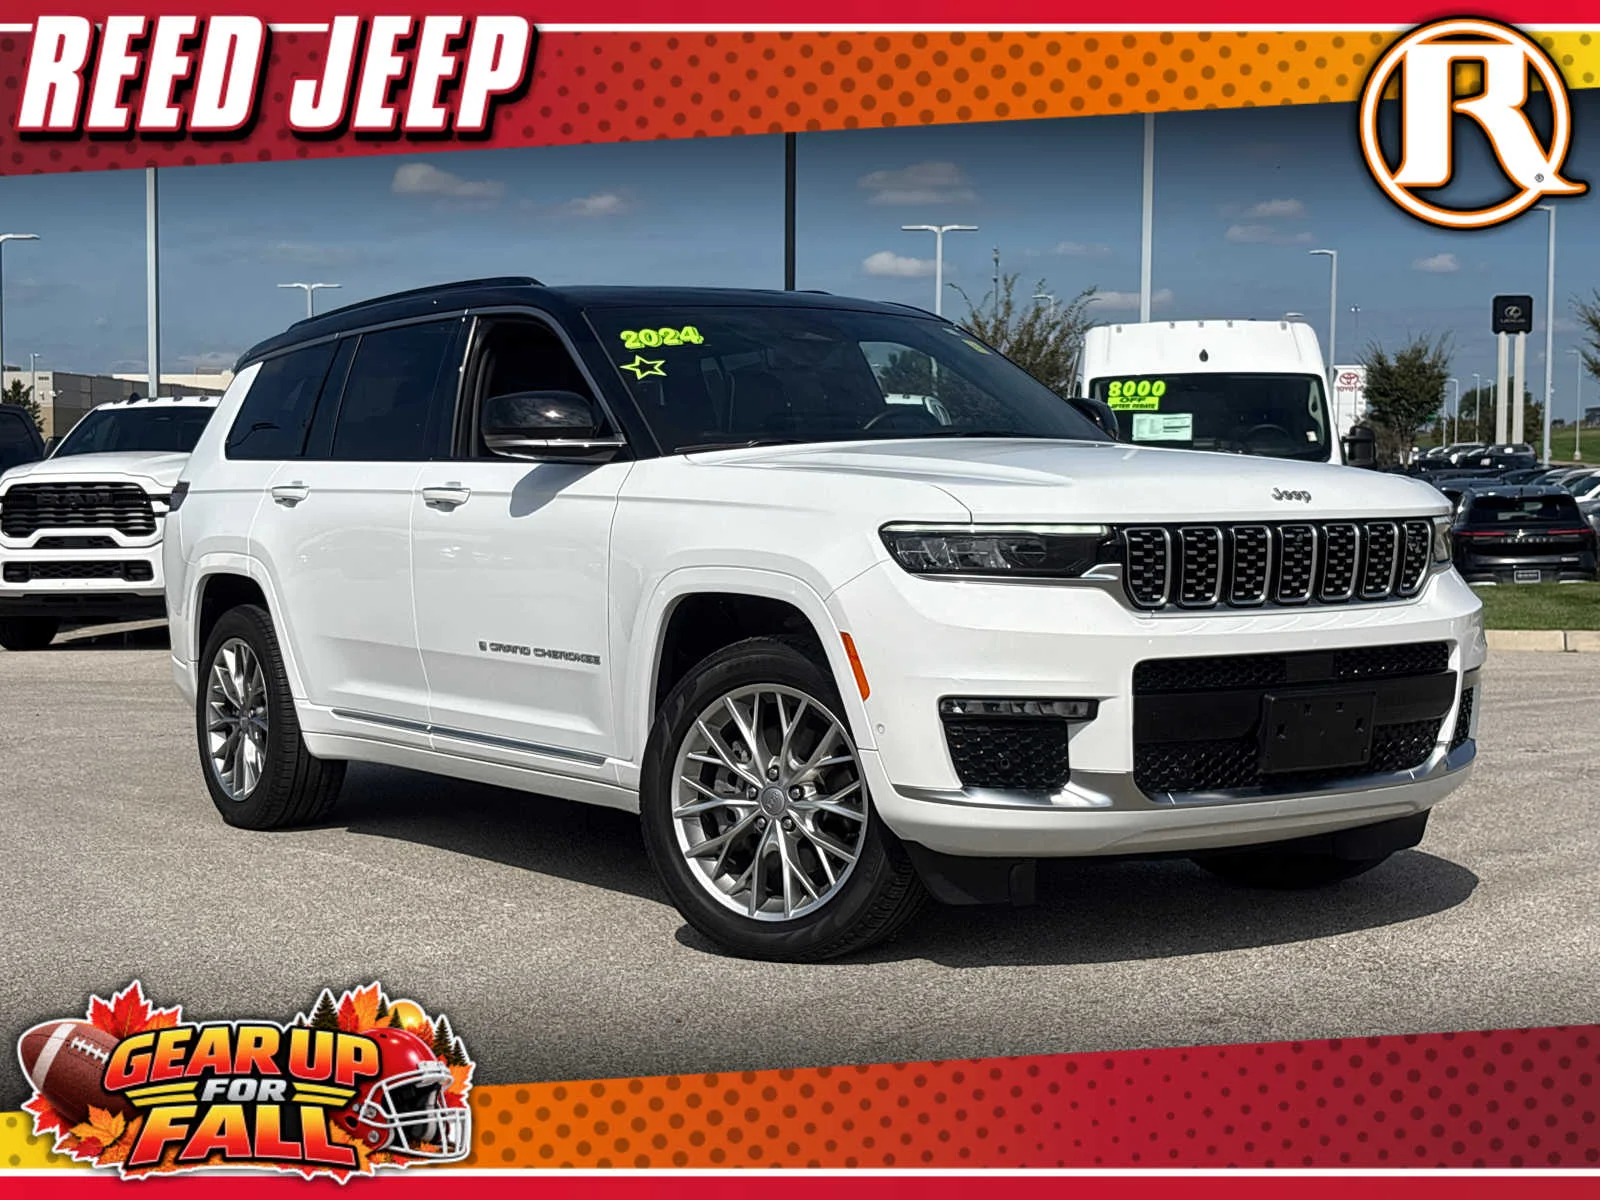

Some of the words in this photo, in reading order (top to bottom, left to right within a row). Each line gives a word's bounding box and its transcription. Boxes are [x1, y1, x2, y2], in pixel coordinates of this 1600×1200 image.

[620, 326, 704, 350] 2024
[1108, 380, 1166, 397] 8000
[1271, 487, 1312, 504] Jeep
[489, 642, 531, 656] GRAND
[533, 647, 601, 665] CHEROKEE
